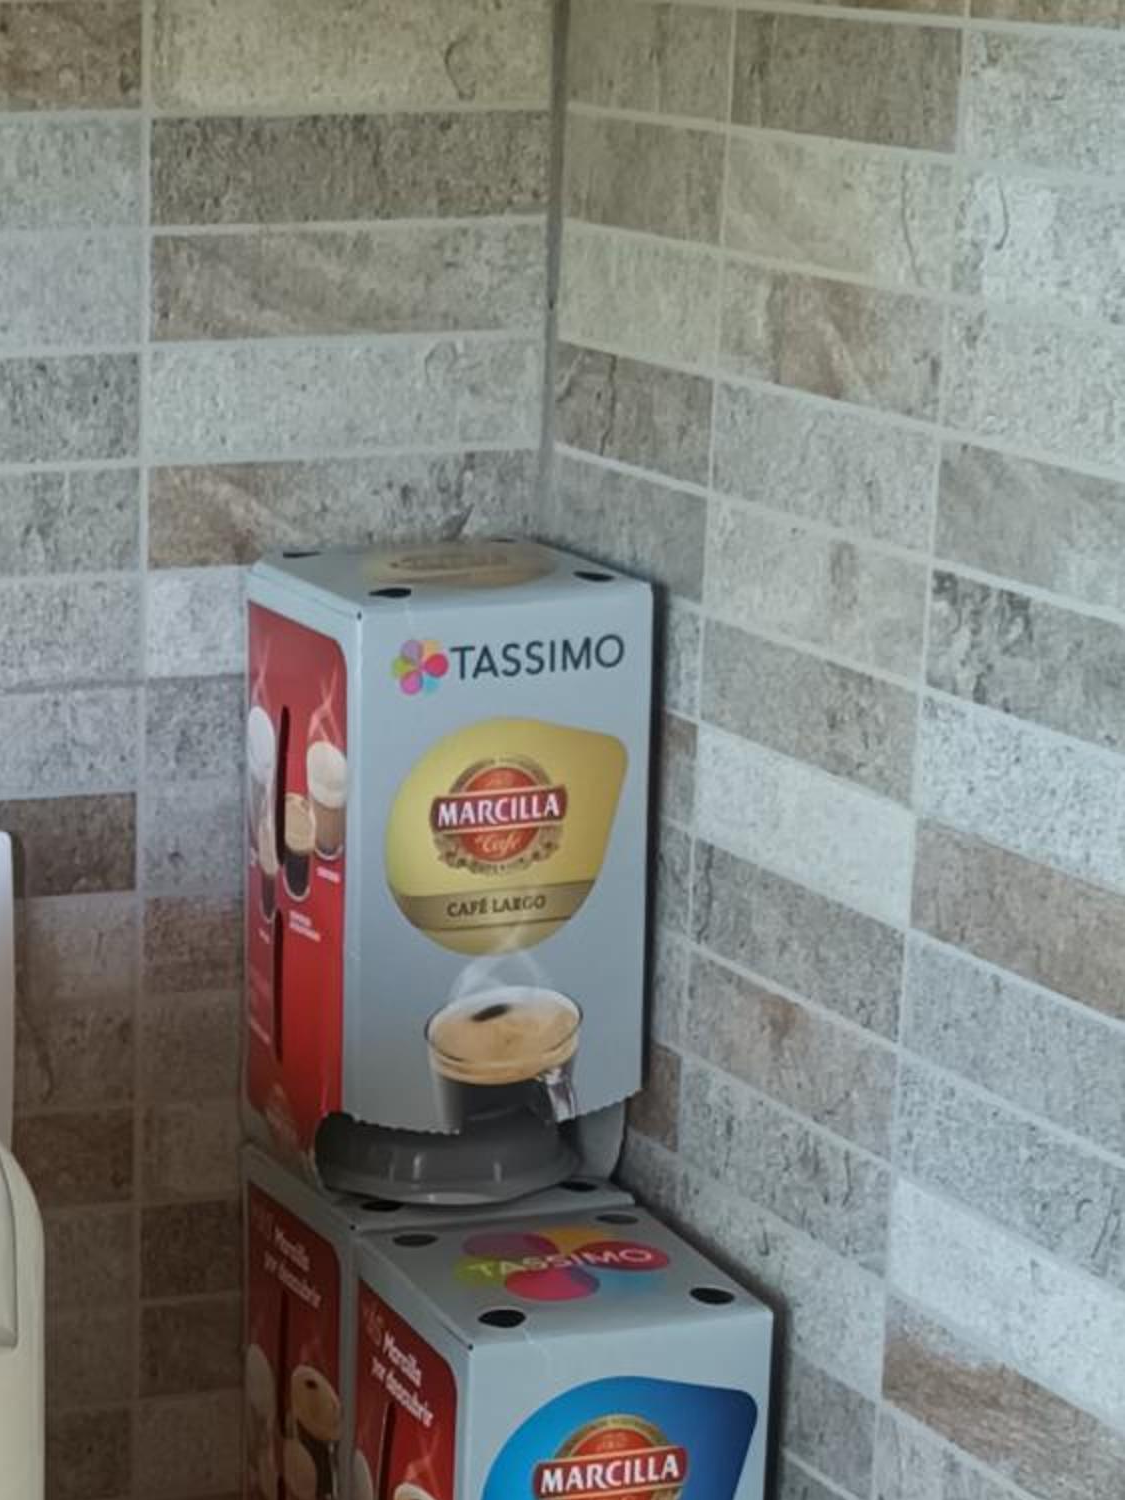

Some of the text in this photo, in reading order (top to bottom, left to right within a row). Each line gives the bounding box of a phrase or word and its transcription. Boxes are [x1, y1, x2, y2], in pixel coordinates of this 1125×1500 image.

[449, 633, 625, 680] TASSIMO
[437, 793, 561, 828] MARCILLA
[446, 895, 488, 918] CAFÉ
[540, 1453, 680, 1495] MARCILLA
